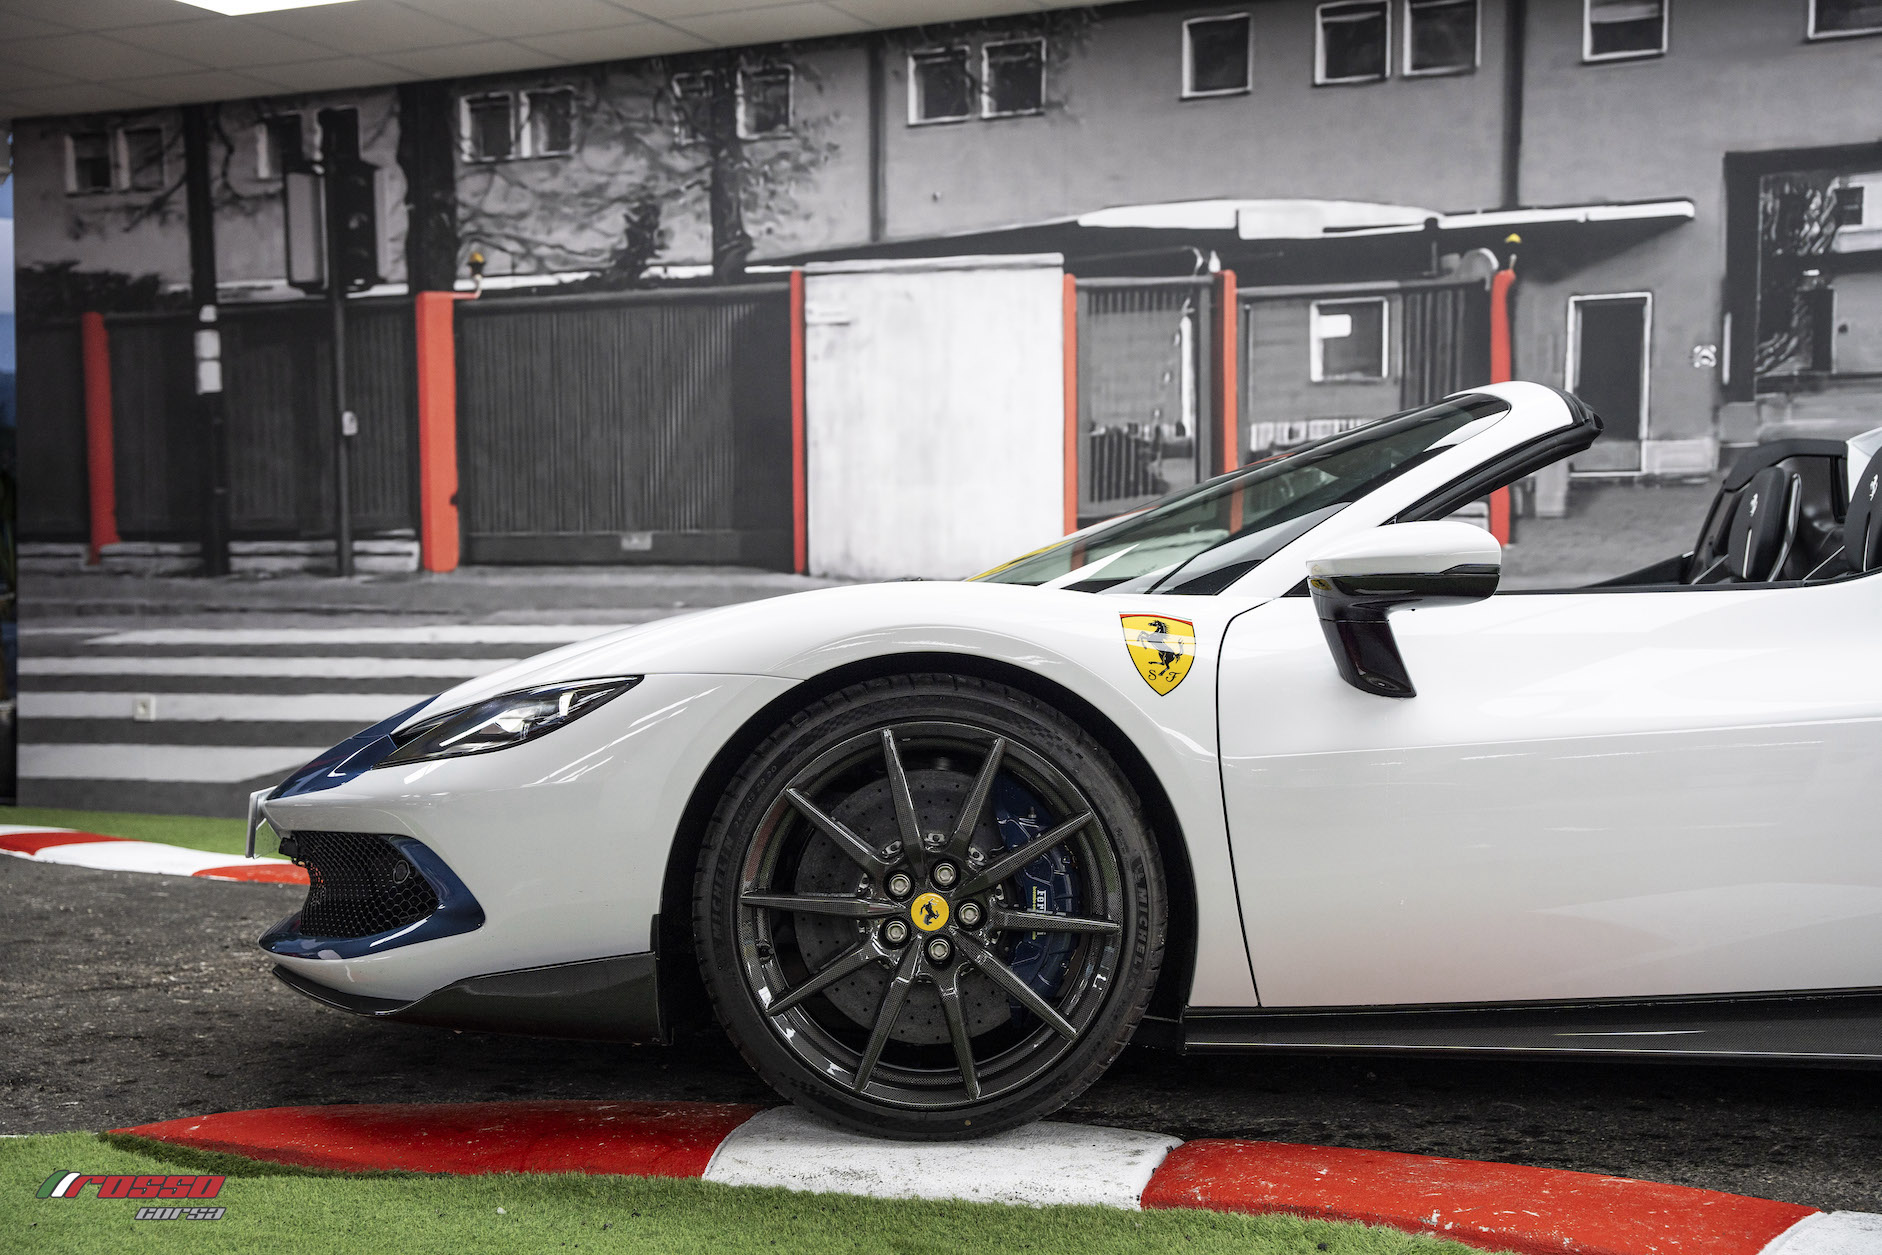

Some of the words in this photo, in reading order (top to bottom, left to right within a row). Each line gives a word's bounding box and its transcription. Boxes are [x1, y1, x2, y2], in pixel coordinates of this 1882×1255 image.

[1147, 668, 1157, 681] S
[711, 835, 735, 941] MICHELIN
[1036, 889, 1047, 936] Feri
[1126, 886, 1148, 992] MICHELIN
